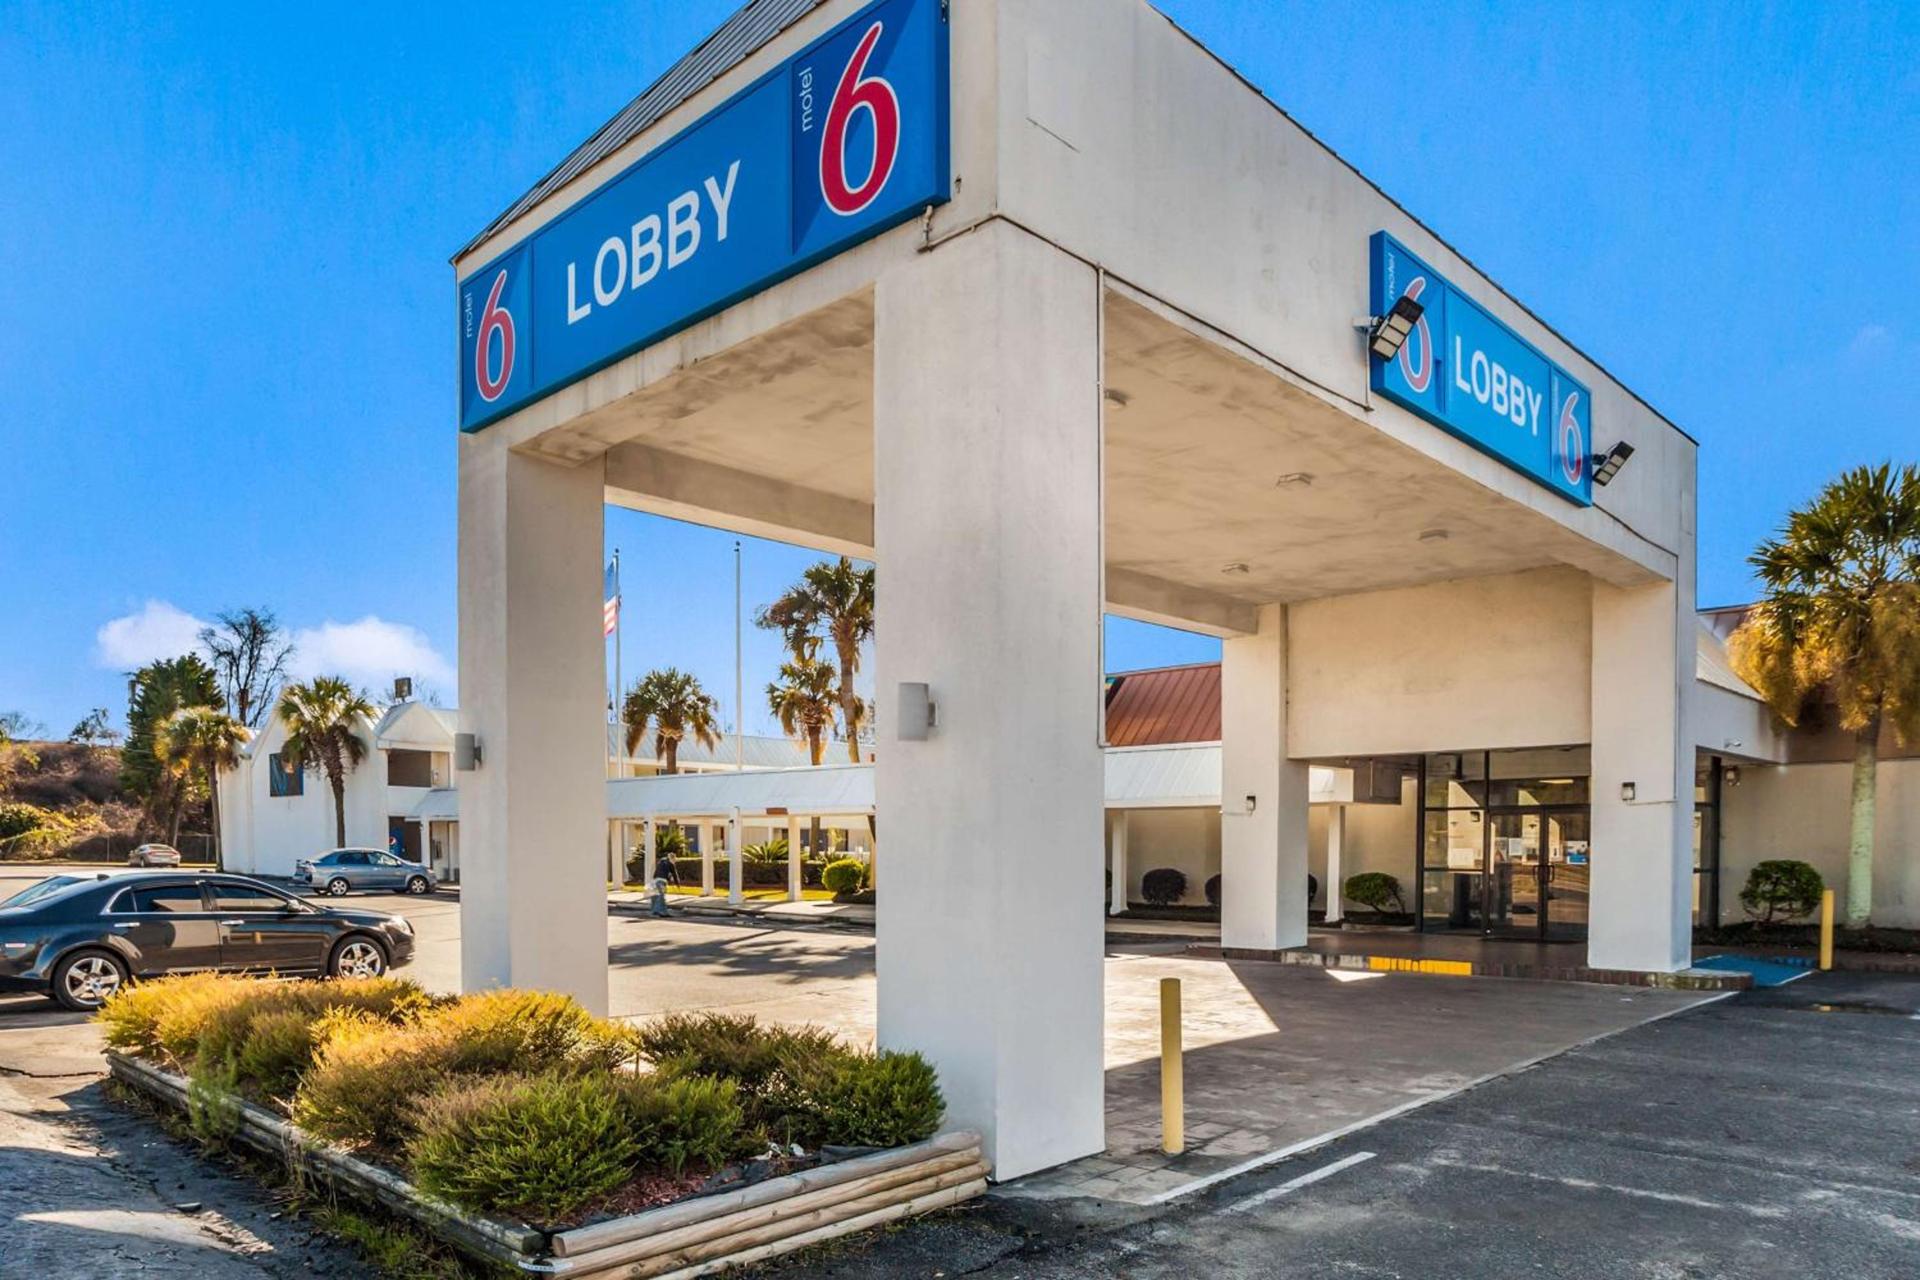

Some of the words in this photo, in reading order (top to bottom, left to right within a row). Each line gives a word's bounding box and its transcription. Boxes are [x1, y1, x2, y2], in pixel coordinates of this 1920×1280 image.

[801, 66, 812, 132] motel
[818, 20, 901, 216] 6
[567, 160, 741, 325] LOBBY
[465, 292, 473, 338] motel
[475, 269, 516, 402] 6
[1455, 335, 1542, 436] LOBBY
[1559, 391, 1582, 484] 6
